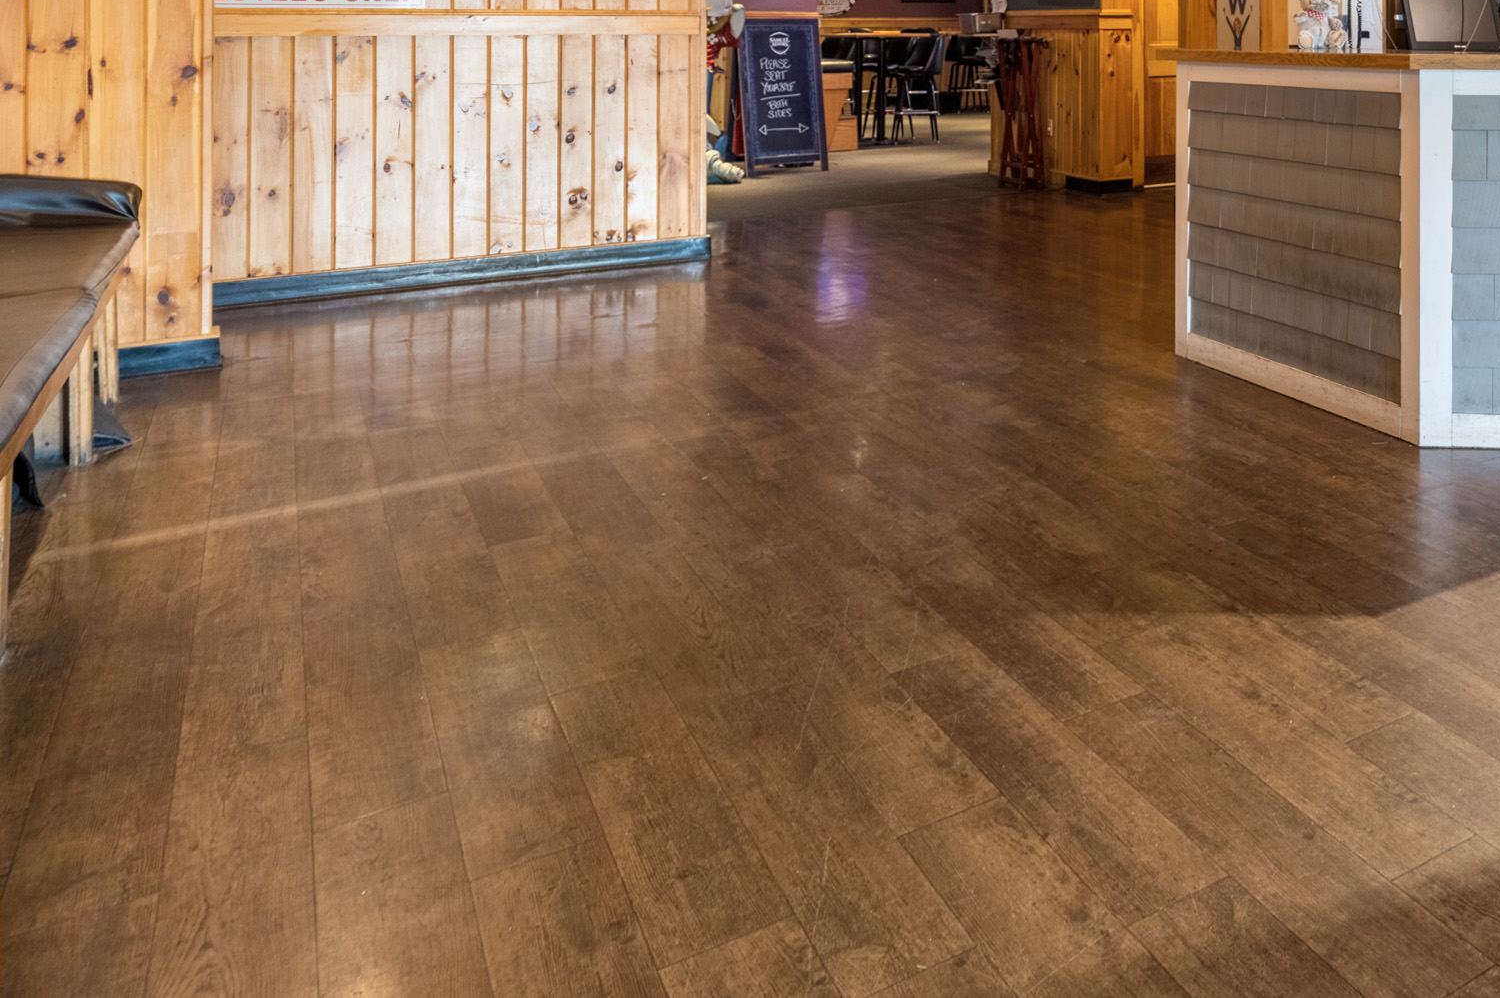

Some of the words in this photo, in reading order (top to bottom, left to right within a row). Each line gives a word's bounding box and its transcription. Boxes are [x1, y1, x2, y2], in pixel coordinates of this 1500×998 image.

[760, 57, 791, 70] PLEASE
[763, 69, 789, 82] SEAT
[760, 81, 797, 95] YOURSELF
[766, 99, 788, 110] BOTH
[766, 107, 793, 119] SIDES
